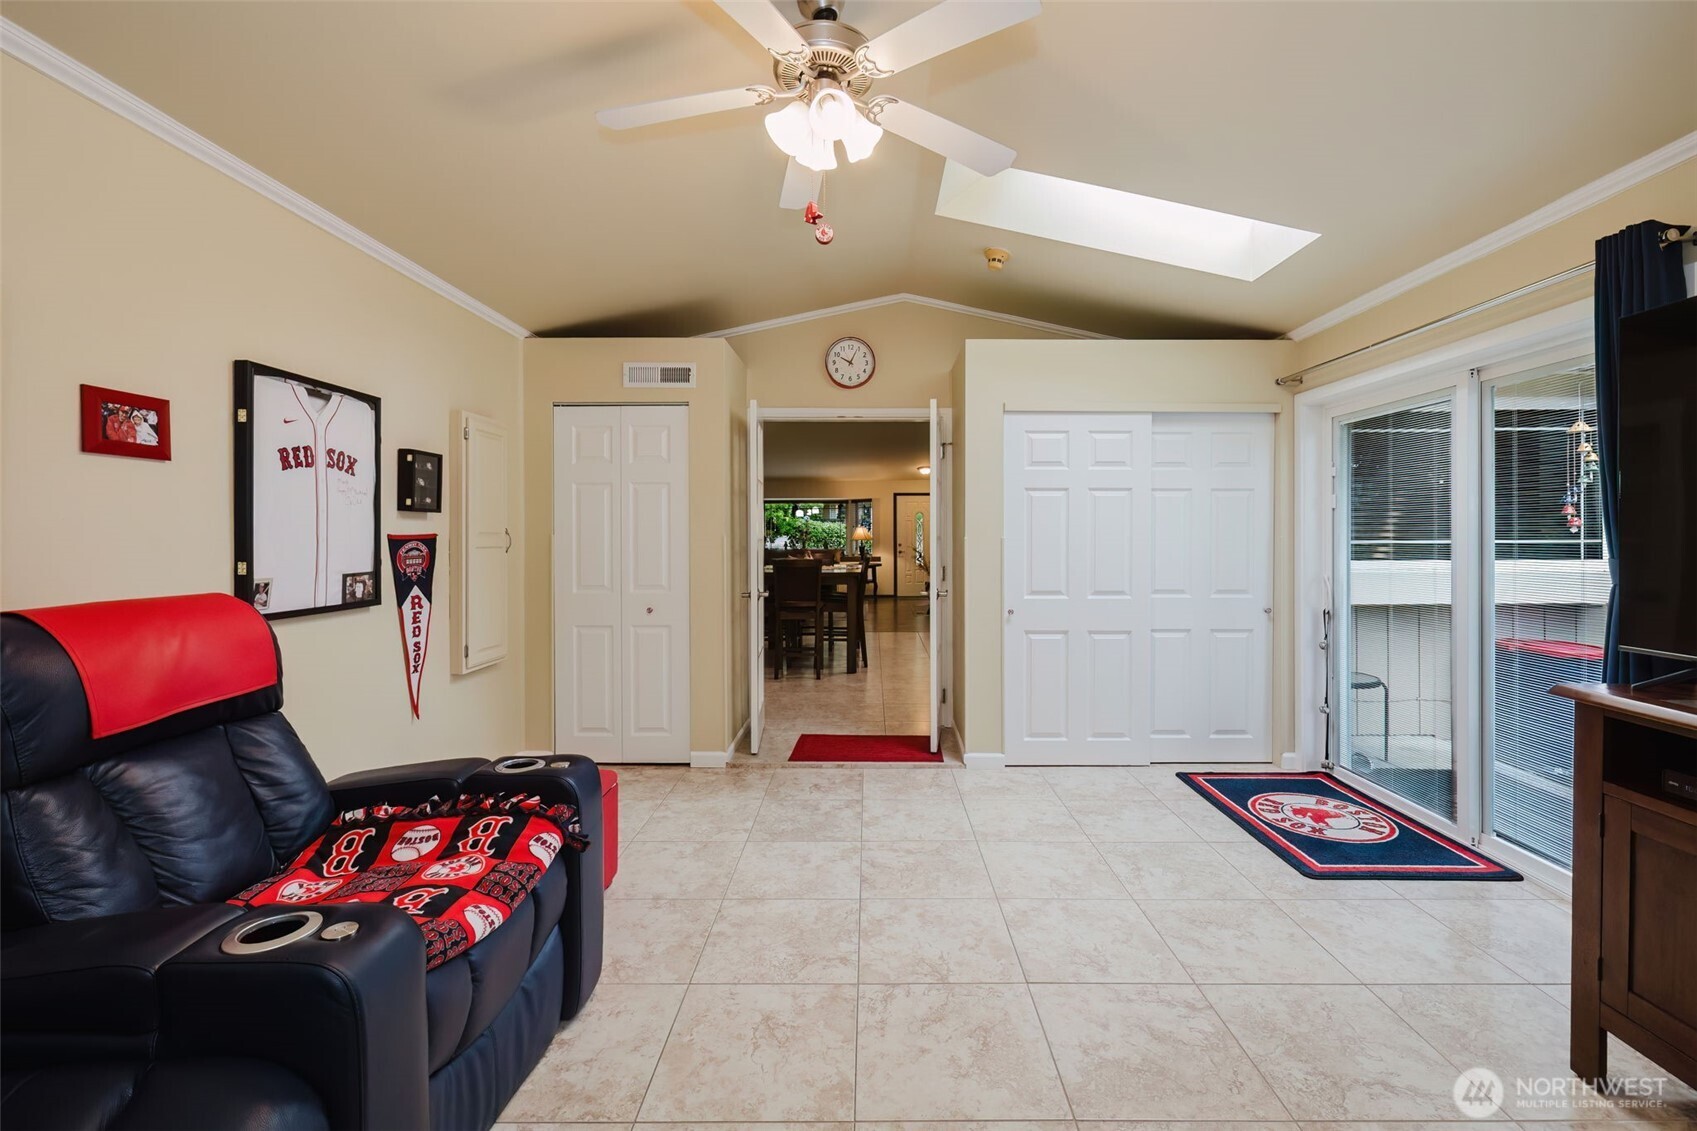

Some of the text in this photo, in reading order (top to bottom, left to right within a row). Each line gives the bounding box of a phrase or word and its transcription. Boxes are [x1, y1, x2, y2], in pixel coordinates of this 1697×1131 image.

[277, 445, 358, 477] RED SOX
[410, 594, 424, 674] RED SOX
[457, 815, 514, 857] B
[1257, 797, 1328, 836] RED SOX
[1315, 797, 1388, 836] BOSTON
[322, 827, 376, 878] B
[397, 832, 440, 846] BOSTON
